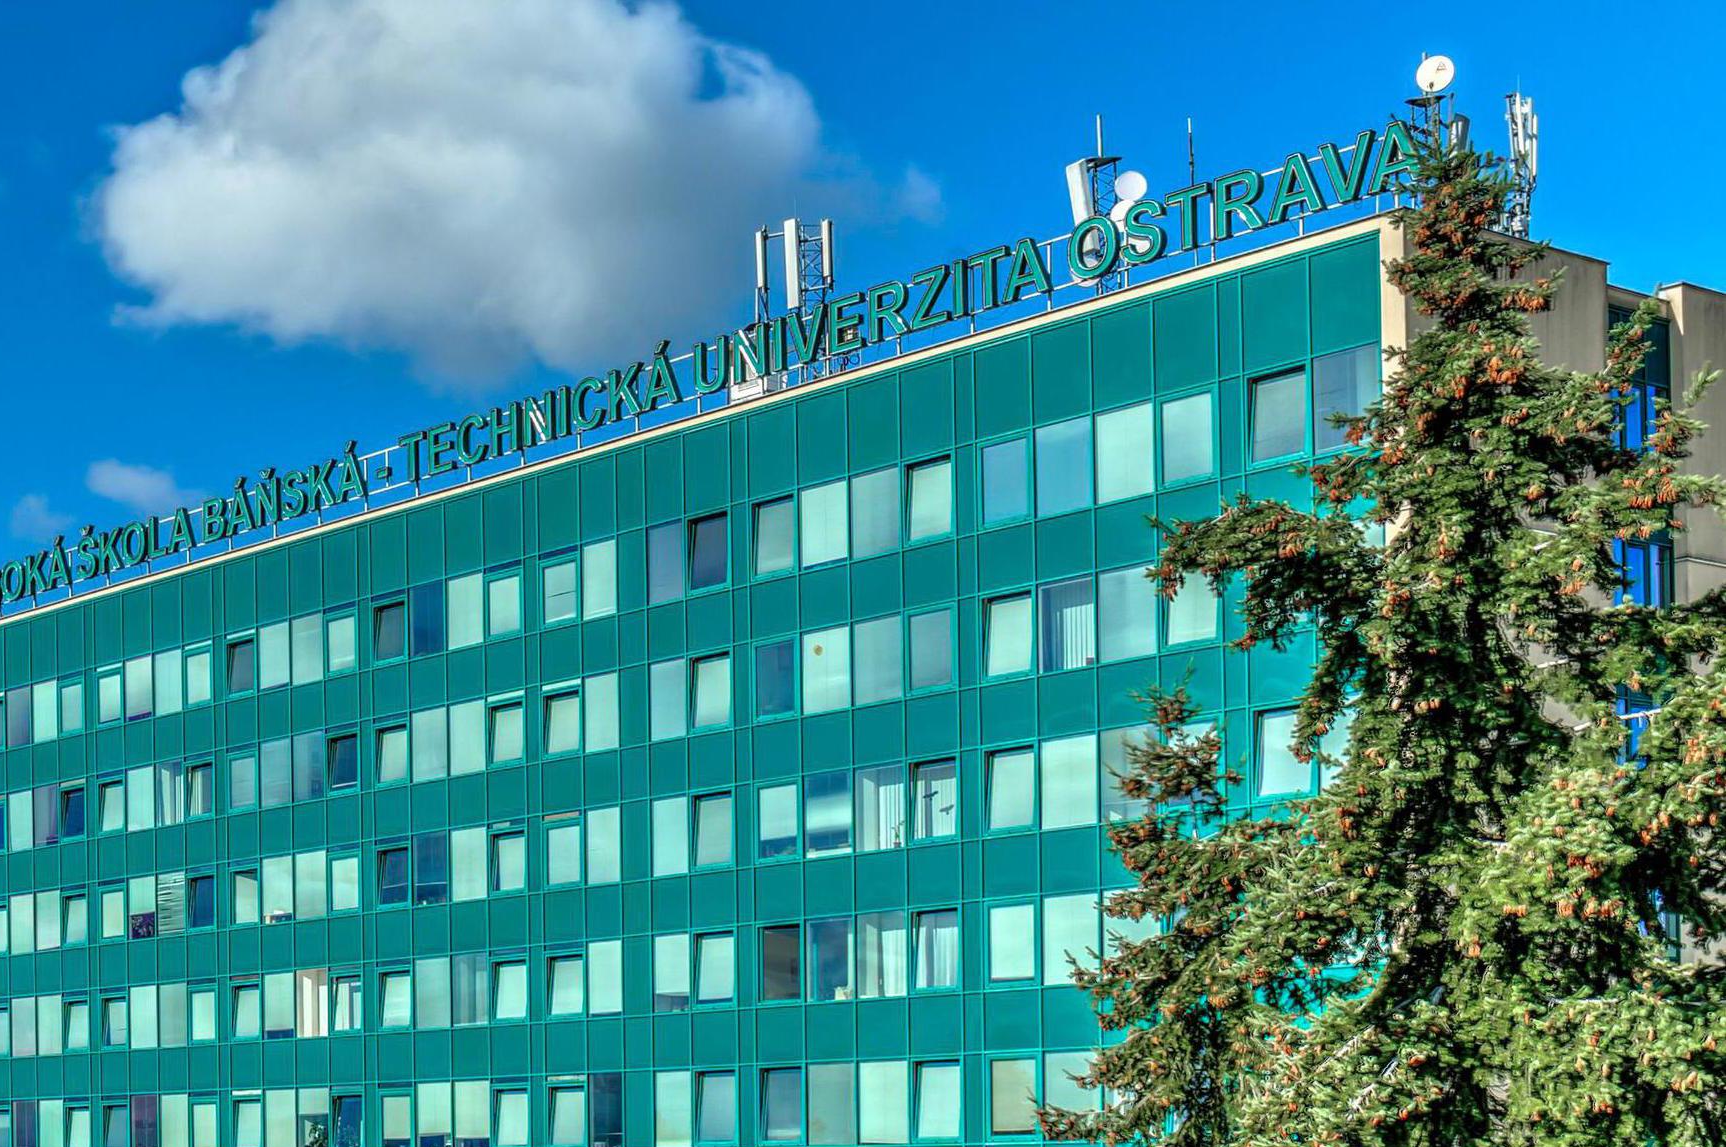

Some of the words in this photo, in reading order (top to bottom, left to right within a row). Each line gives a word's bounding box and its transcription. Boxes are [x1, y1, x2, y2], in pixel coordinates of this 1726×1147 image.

[75, 507, 195, 579] ŠKOLA
[201, 440, 365, 542] BÁŇSKÁ
[398, 339, 684, 483] TECHNICKÁ
[693, 237, 1052, 394] UNIVERZITA
[1068, 121, 1421, 280] OSTRAVA
